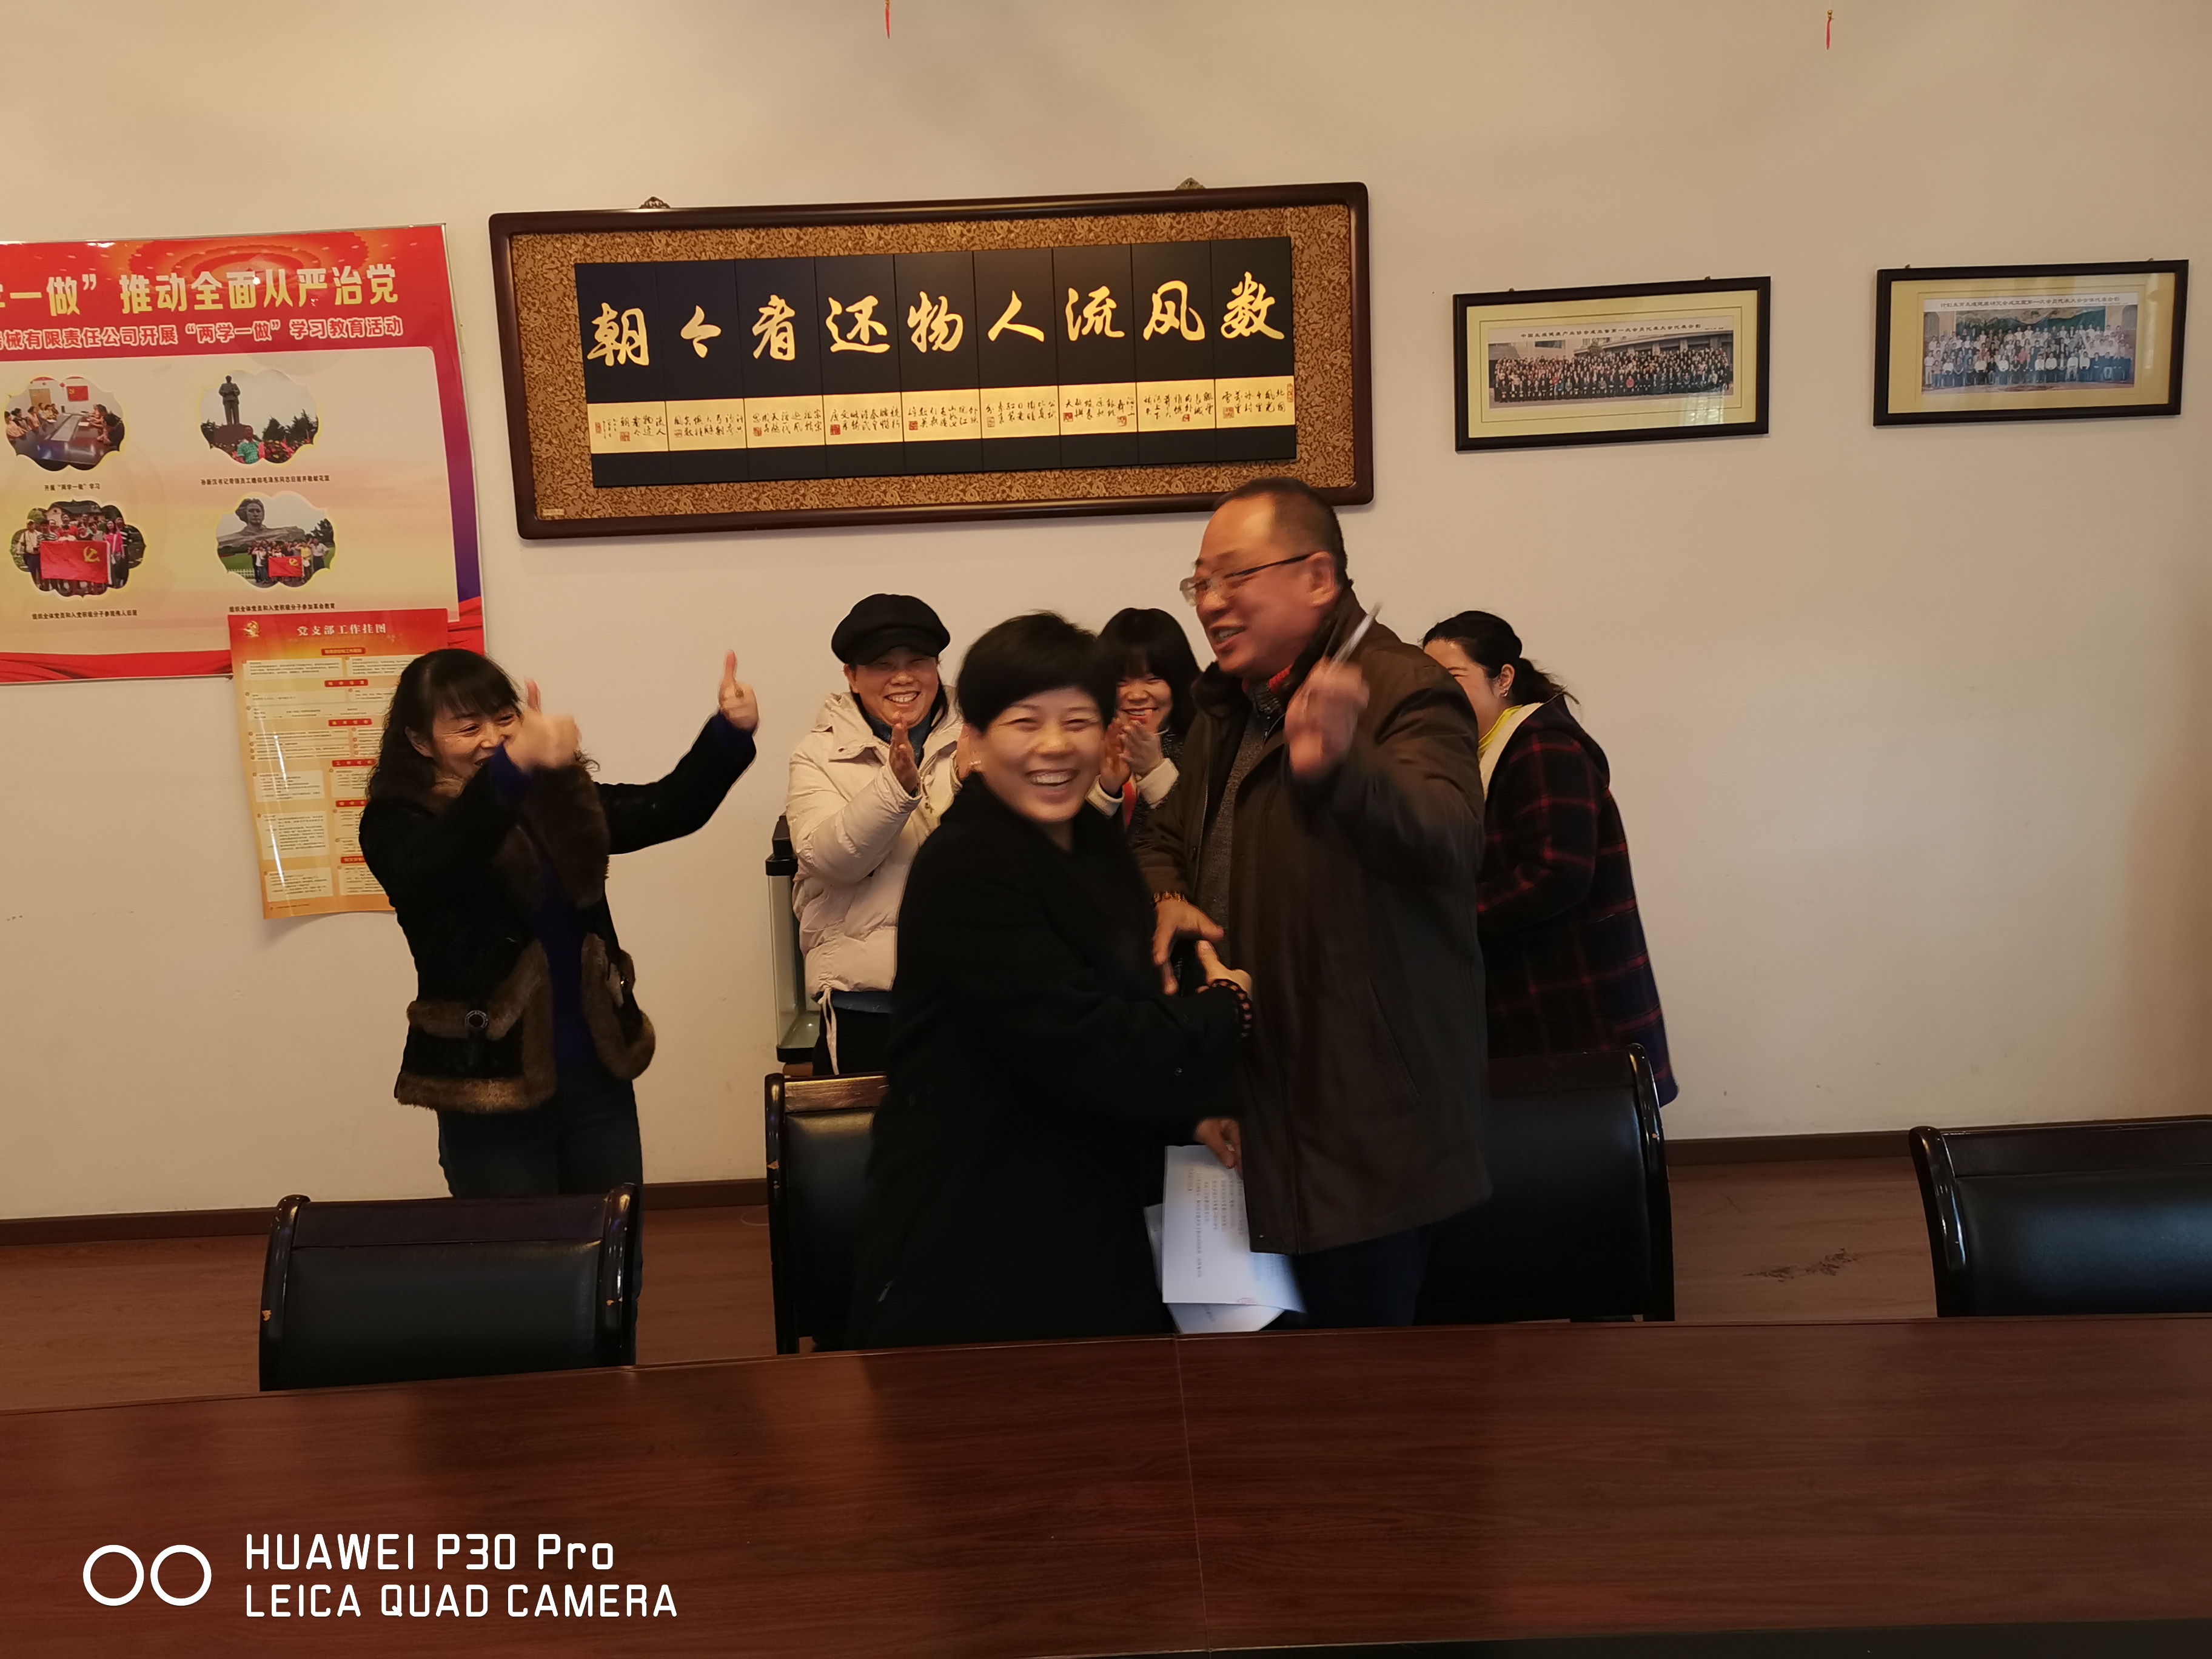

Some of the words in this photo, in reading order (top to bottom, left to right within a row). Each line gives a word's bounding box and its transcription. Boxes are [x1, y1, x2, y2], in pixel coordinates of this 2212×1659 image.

[297, 623, 386, 637] 党支部工作挂图
